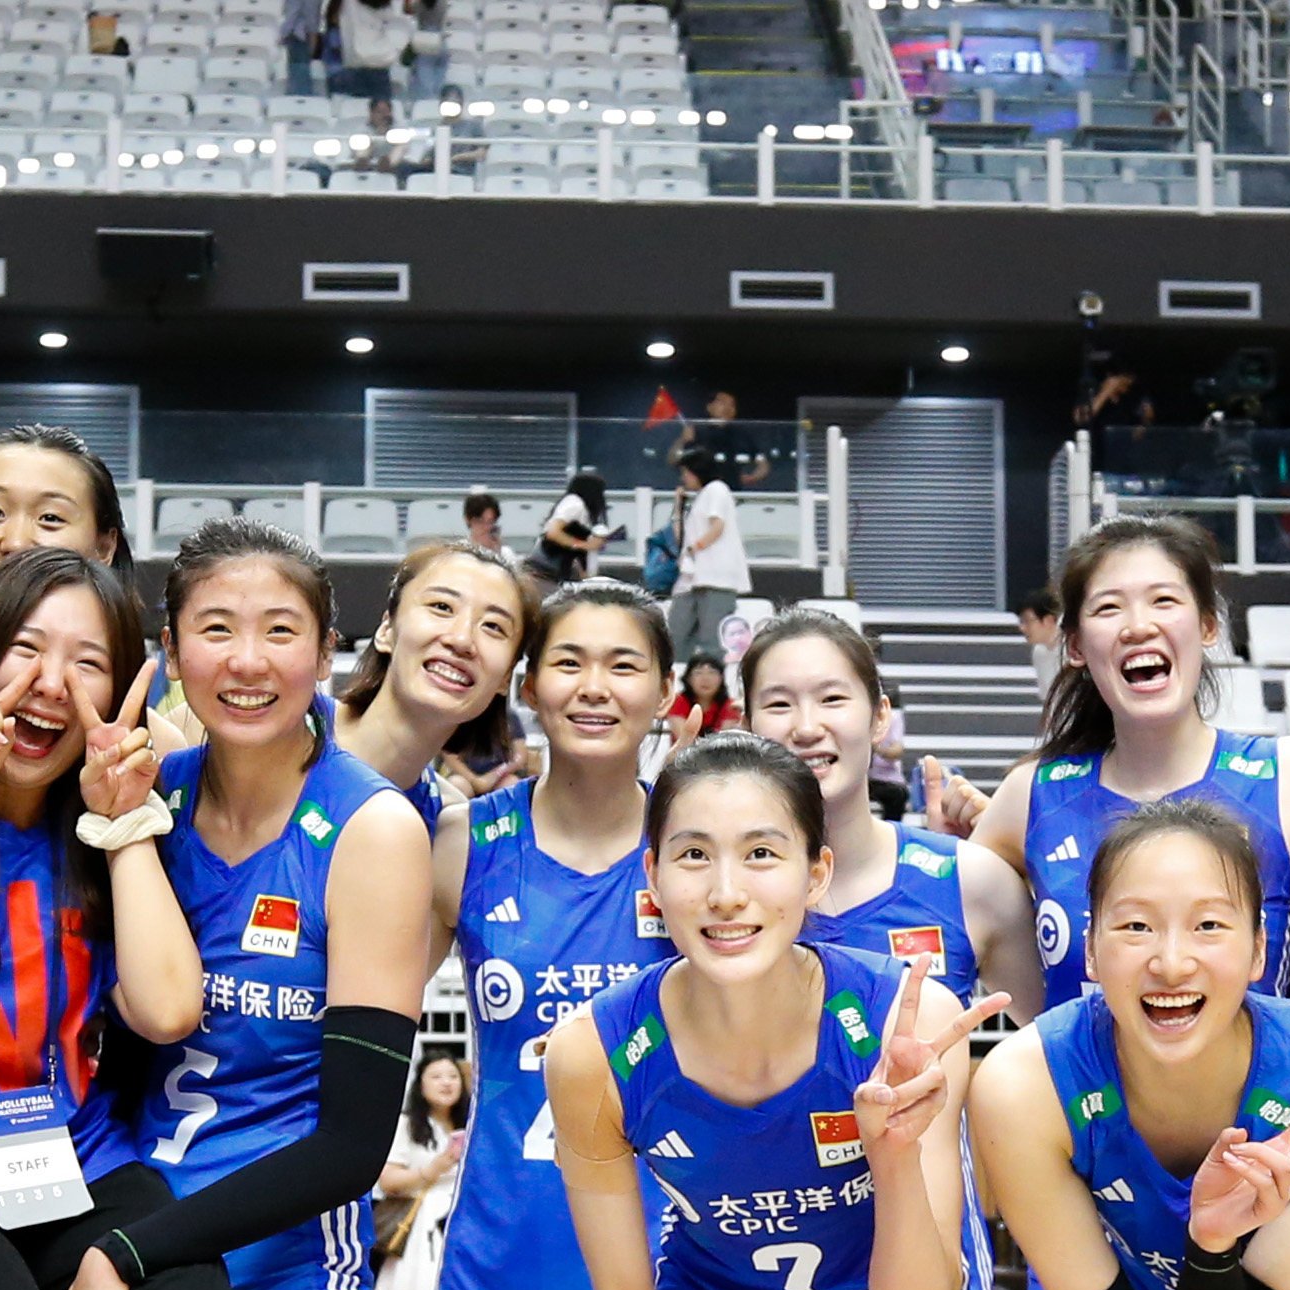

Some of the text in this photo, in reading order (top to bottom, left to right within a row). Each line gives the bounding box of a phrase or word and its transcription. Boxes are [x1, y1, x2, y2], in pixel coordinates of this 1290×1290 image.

[250, 932, 290, 950] CHN
[150, 1046, 219, 1165] 5
[7, 1156, 51, 1174] STAFF
[15, 1191, 26, 1204] 2
[719, 1215, 799, 1236] CPIC
